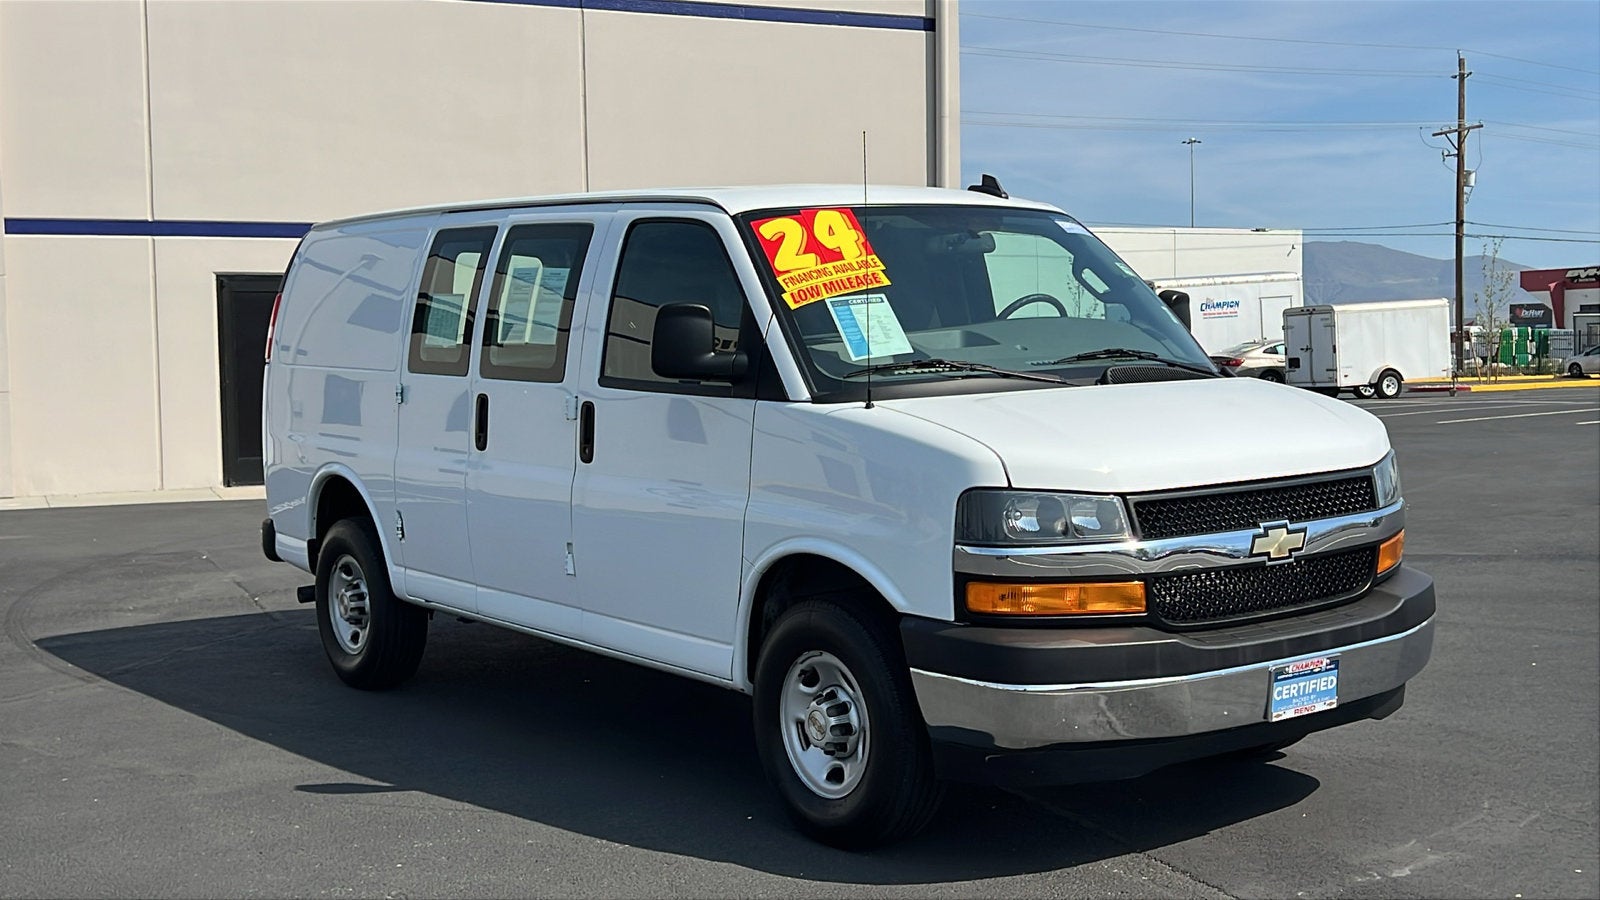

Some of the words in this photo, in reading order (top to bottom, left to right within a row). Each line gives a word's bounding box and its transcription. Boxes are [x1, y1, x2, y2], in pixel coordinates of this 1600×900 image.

[758, 209, 867, 272] 24
[782, 266, 833, 288] FINANCING
[832, 257, 880, 276] AVAILABLE
[790, 285, 822, 305] LOW
[822, 272, 882, 295] MILEAGE
[1200, 301, 1240, 311] CHAMPION
[1291, 659, 1323, 672] CHAMPION
[1274, 675, 1337, 700] CERTIFIED
[1293, 705, 1316, 715] RENO
